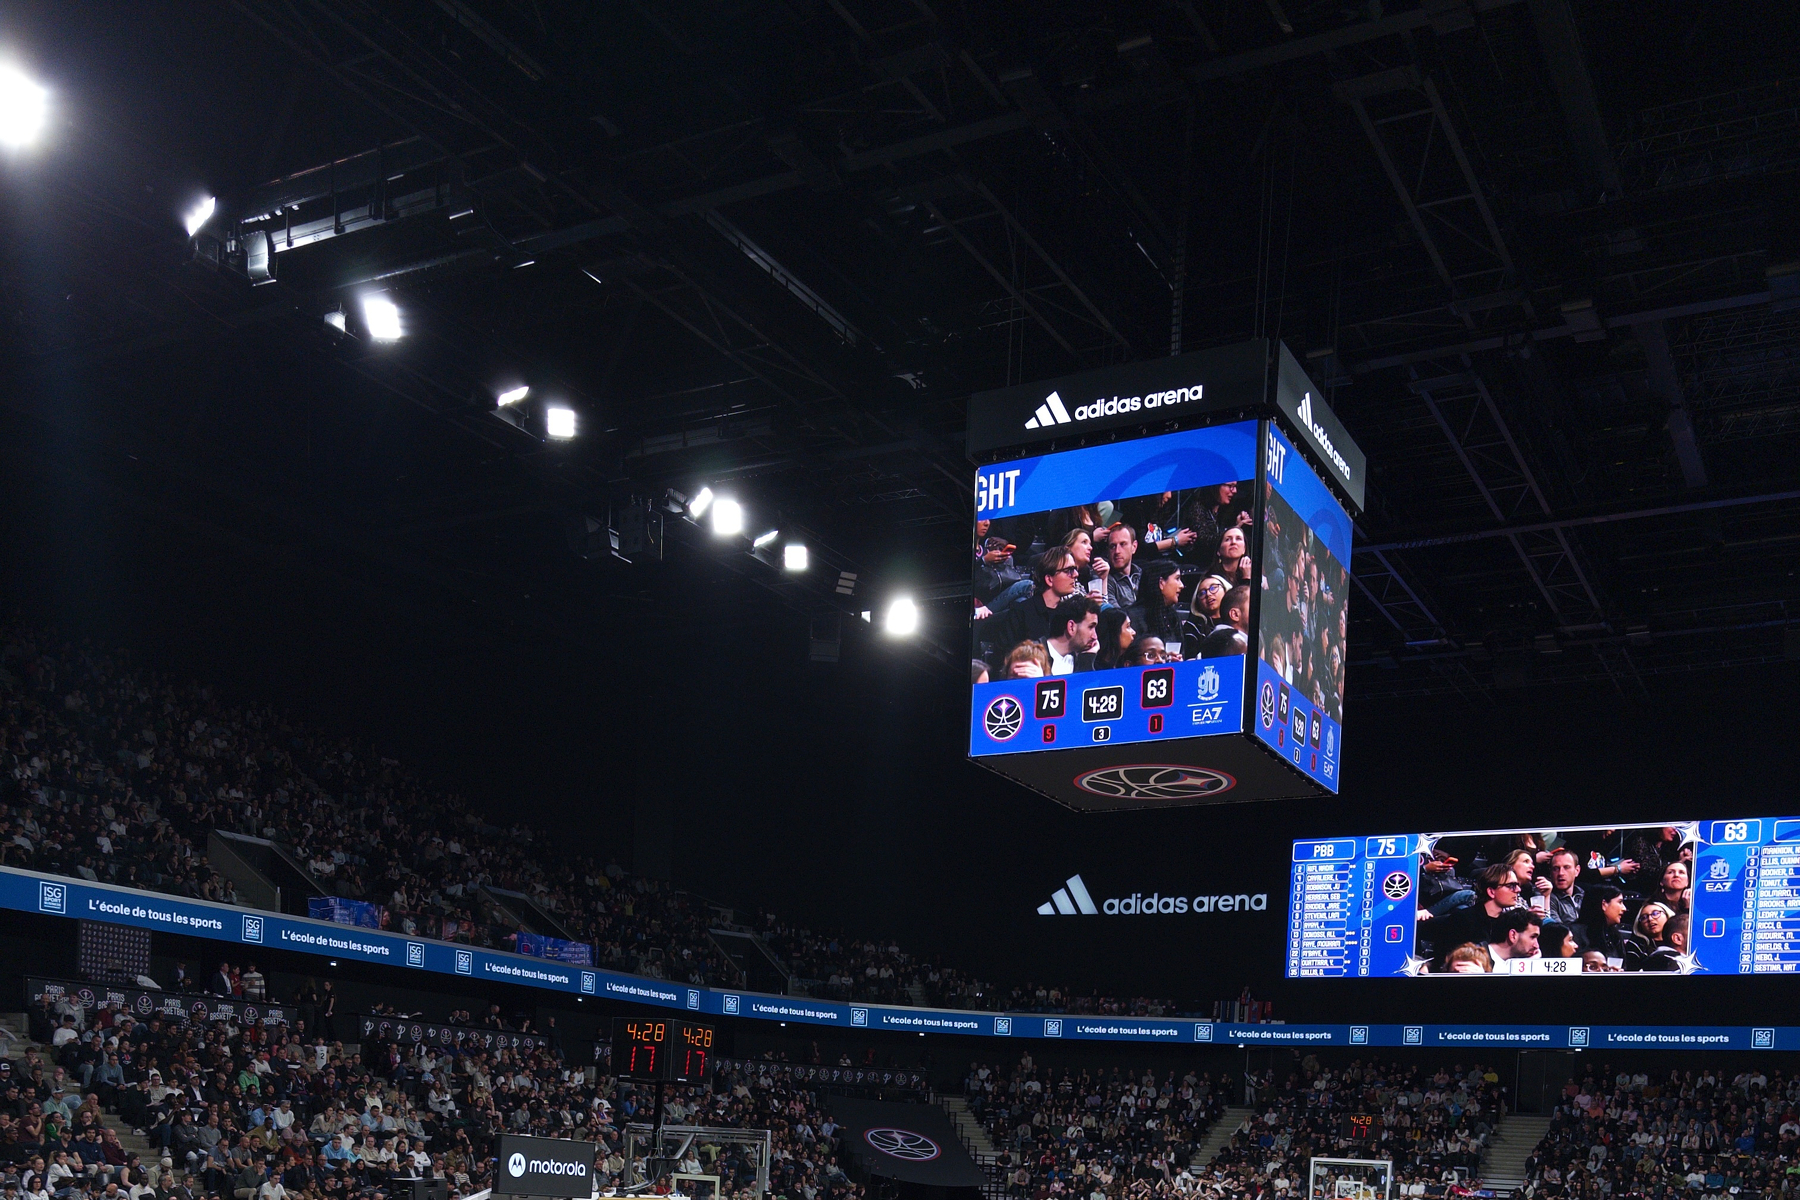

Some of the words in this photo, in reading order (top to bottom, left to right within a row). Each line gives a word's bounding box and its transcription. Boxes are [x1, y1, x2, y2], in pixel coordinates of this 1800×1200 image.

[1074, 396, 1141, 421] adidas
[1144, 384, 1204, 408] arena
[1313, 423, 1334, 457] adidas
[1333, 450, 1351, 481] arena
[1146, 679, 1167, 698] 63
[1041, 690, 1060, 709] 75
[1088, 693, 1117, 714] 4:28
[1192, 707, 1222, 723] EA7
[1153, 718, 1159, 730] 1
[1045, 728, 1052, 740] 5
[1098, 728, 1105, 739] 3
[1724, 822, 1747, 842] 63
[1313, 844, 1334, 858] PBB
[1377, 838, 1396, 856] 75
[44, 886, 62, 898] ISG
[1705, 882, 1732, 891] EA7
[1103, 893, 1189, 915] adidas
[1193, 893, 1267, 913] arena
[89, 900, 130, 915] L'école
[132, 906, 146, 917] de
[148, 909, 171, 921] tous
[173, 911, 188, 925] les
[189, 915, 223, 930] sports
[246, 918, 260, 930] ISG
[1712, 921, 1717, 933] 1
[1390, 928, 1398, 939] 5
[282, 930, 315, 943] L'école
[317, 935, 327, 945] de
[329, 937, 348, 948] tous
[350, 940, 361, 950] les
[363, 944, 389, 955] sports
[409, 945, 422, 955] ISG
[458, 954, 470, 964] ISG
[486, 962, 511, 974] L'école
[512, 966, 521, 975] de
[522, 968, 536, 978] tous
[538, 970, 547, 980] les
[548, 974, 568, 983] sports
[1518, 961, 1525, 973] 3
[1544, 961, 1567, 973] 4:28
[1741, 964, 1750, 972] 77
[583, 974, 593, 983] ISG
[45, 984, 65, 995] PARIS
[106, 991, 126, 1003] PARIS
[726, 997, 738, 1005] ISG
[164, 998, 182, 1009] PARIS
[217, 1003, 234, 1014] PARIS
[268, 1009, 285, 1020] PARIS
[753, 1003, 778, 1014] L'école
[779, 1006, 788, 1015] de
[790, 1007, 804, 1016] tous
[805, 1009, 814, 1017] les
[816, 1011, 837, 1019] sports
[853, 1010, 865, 1018] ISG
[884, 1015, 911, 1025] L'école
[913, 1017, 922, 1025] de
[924, 1018, 940, 1027] tous
[942, 1019, 952, 1027] les
[954, 1021, 977, 1029] sports
[627, 1023, 665, 1042] 4:28
[1078, 1025, 1106, 1034] L'école
[1108, 1026, 1118, 1034] de
[1120, 1027, 1137, 1035] tous
[1139, 1027, 1150, 1035] les
[1152, 1028, 1177, 1037] sports
[1230, 1030, 1259, 1038] L'école
[1261, 1031, 1271, 1039] de
[1273, 1031, 1291, 1039] tous
[1293, 1031, 1304, 1039] les
[1306, 1032, 1331, 1041] sports
[1406, 1028, 1419, 1036] ISG
[1439, 1032, 1471, 1040] L'école
[1473, 1032, 1483, 1040] de
[1486, 1033, 1504, 1041] tous
[1507, 1032, 1519, 1041] les
[1521, 1033, 1549, 1042] sports
[683, 1027, 713, 1048] 4:28
[1609, 1033, 1642, 1042] L'école
[1645, 1033, 1656, 1042] de
[1659, 1034, 1679, 1042] tous
[1682, 1034, 1695, 1043] les
[1698, 1034, 1729, 1044] sports
[320, 1052, 325, 1060] 2
[630, 1045, 656, 1073] 17
[685, 1049, 706, 1077] 17
[1350, 1115, 1372, 1126] 4:28
[1352, 1126, 1367, 1138] 17
[529, 1158, 586, 1178] motorola
